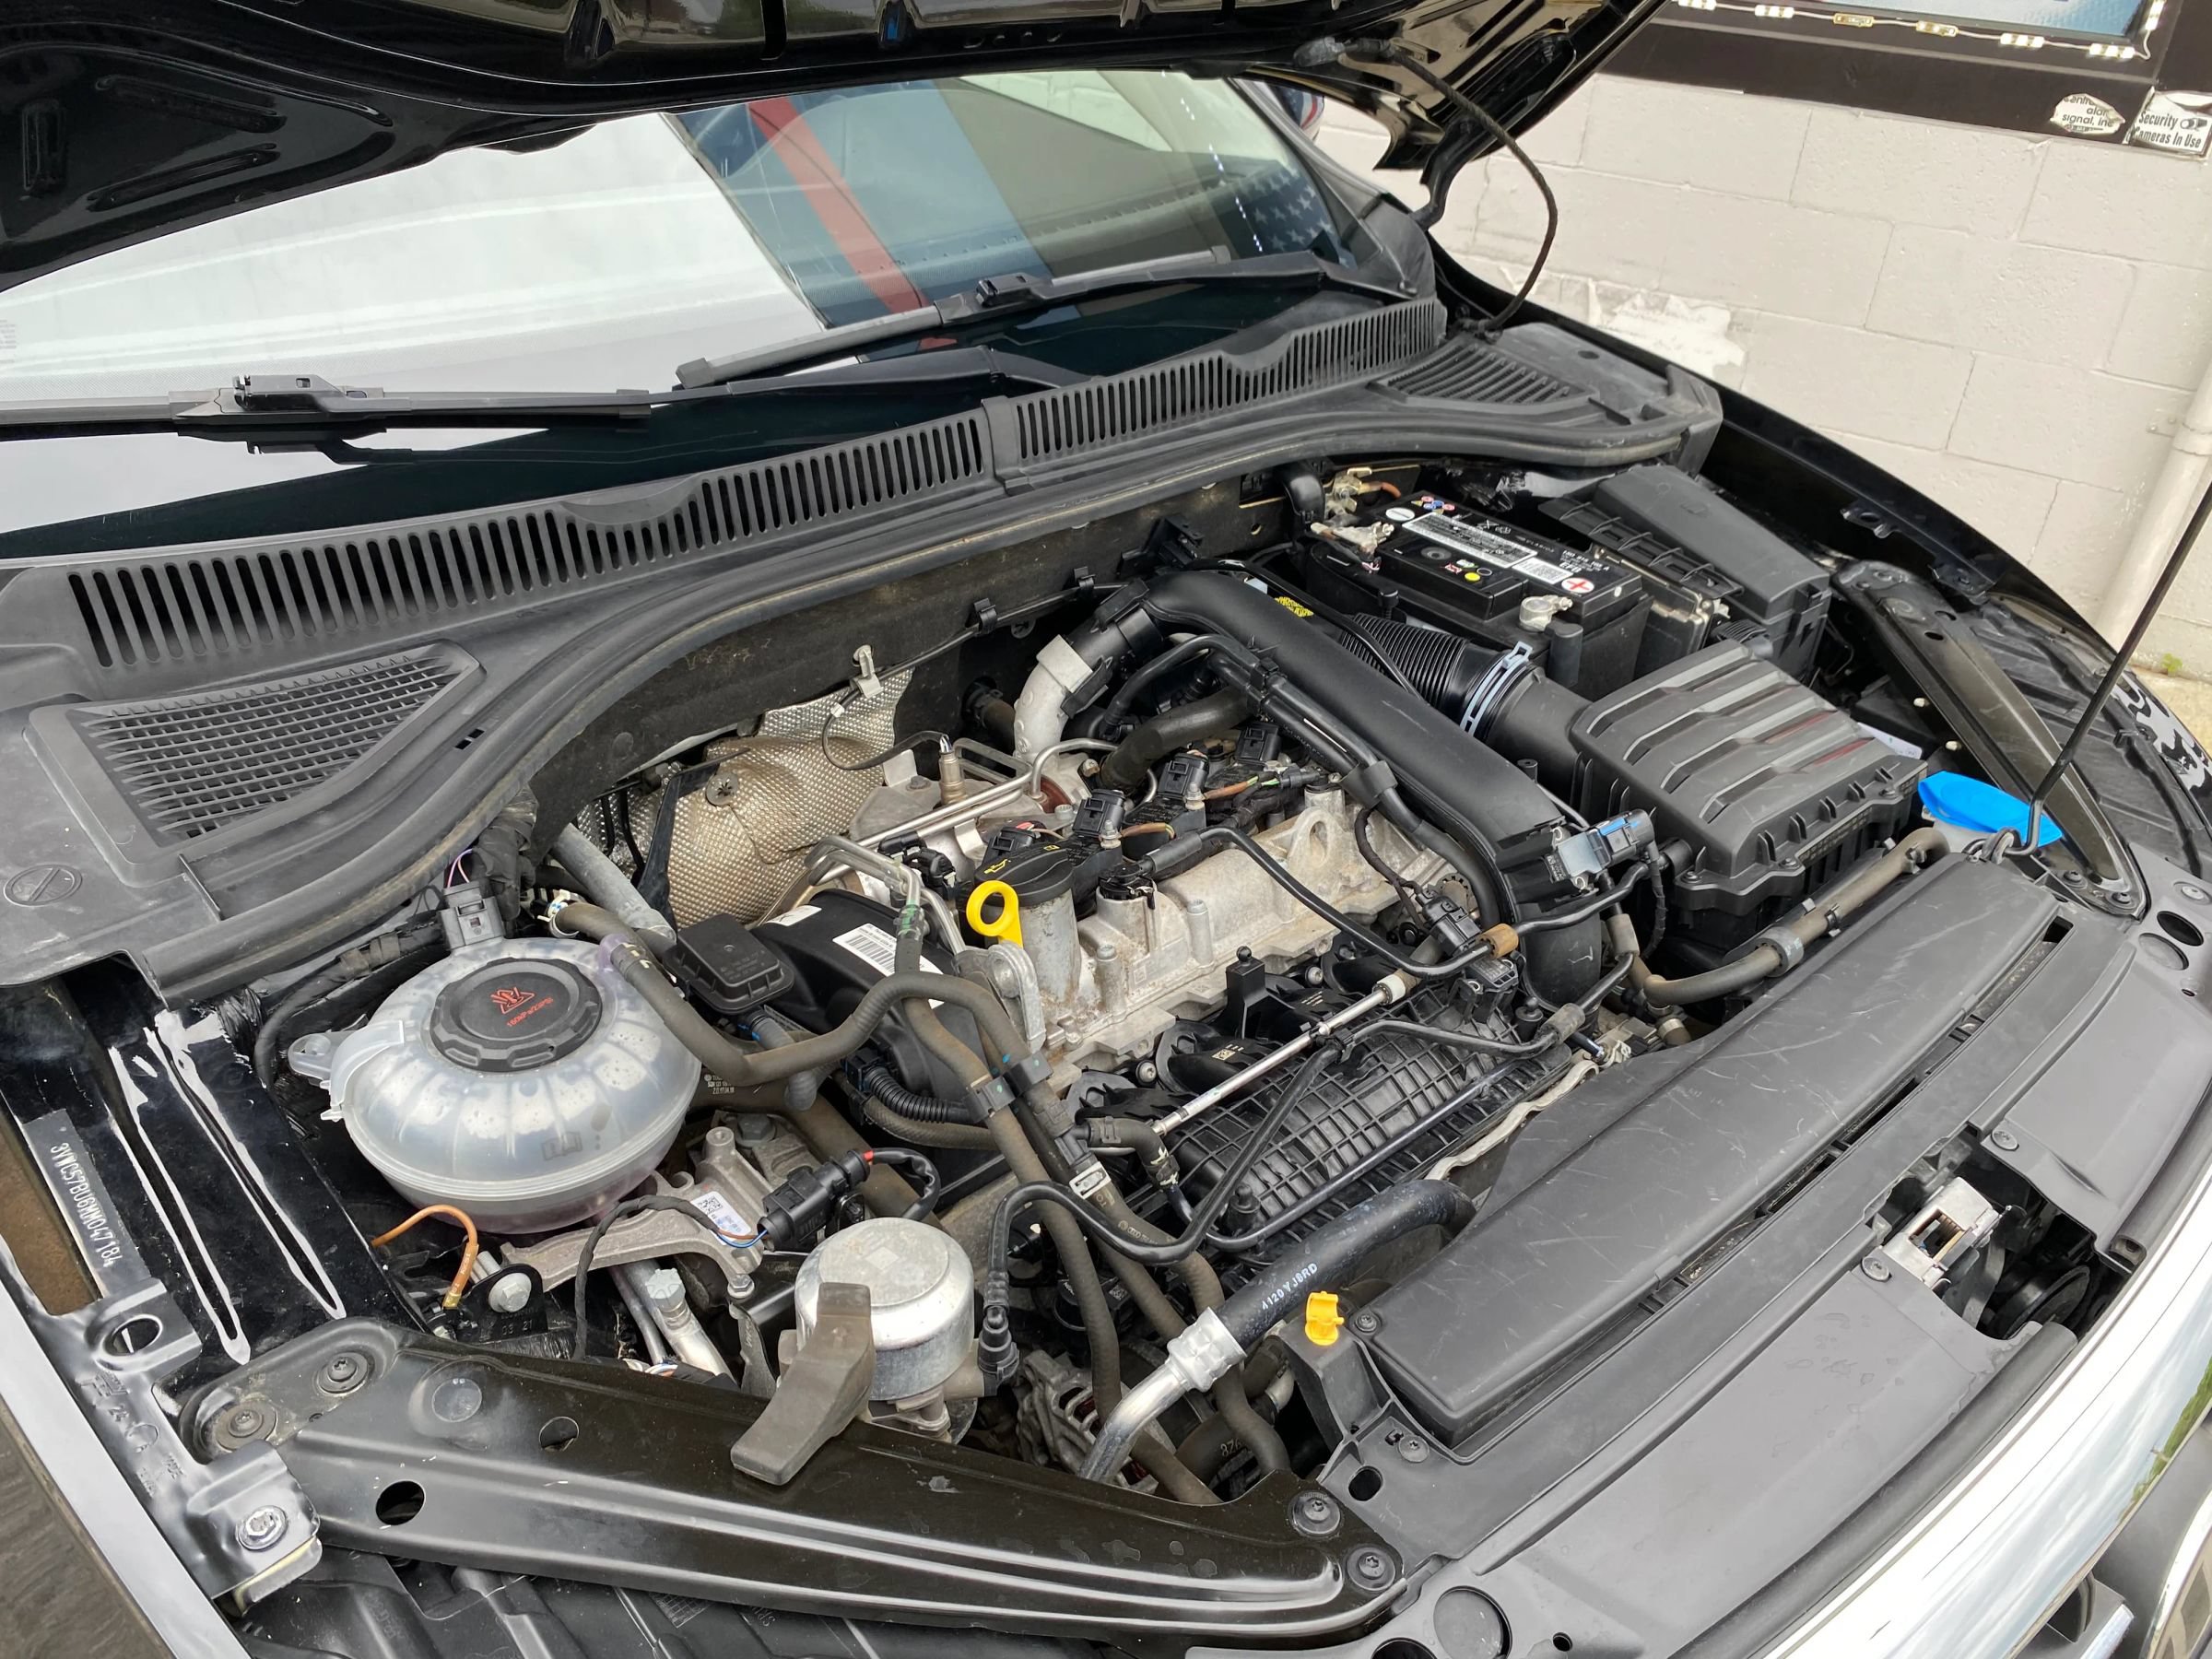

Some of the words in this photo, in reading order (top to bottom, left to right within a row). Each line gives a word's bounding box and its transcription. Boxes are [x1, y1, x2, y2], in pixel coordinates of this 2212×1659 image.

[2138, 111, 2179, 130] Security
[2172, 132, 2183, 146] In
[2184, 134, 2202, 148] Use
